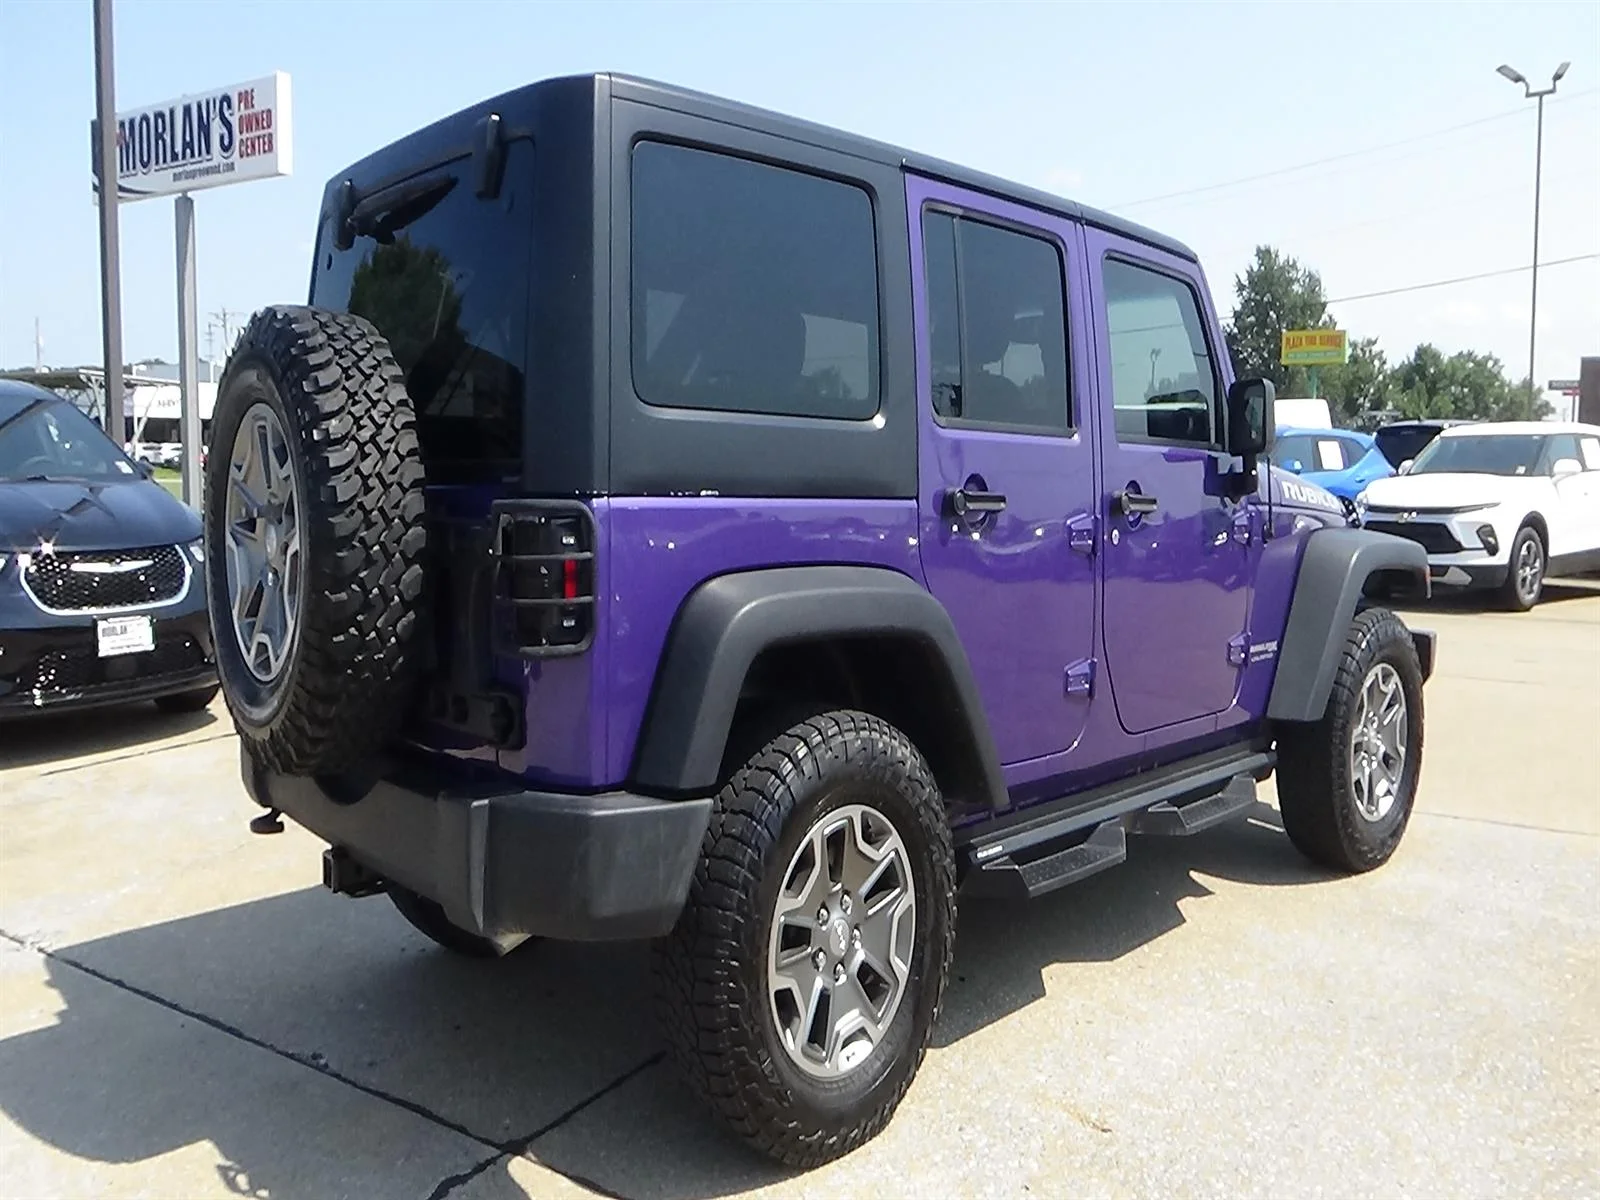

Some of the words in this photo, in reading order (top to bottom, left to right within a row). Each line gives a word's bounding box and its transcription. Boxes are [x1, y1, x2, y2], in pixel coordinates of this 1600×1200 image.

[238, 88, 255, 112] PRE
[117, 93, 234, 173] MORLAN'S
[238, 108, 272, 136] OWNED
[239, 132, 273, 158] CENTER
